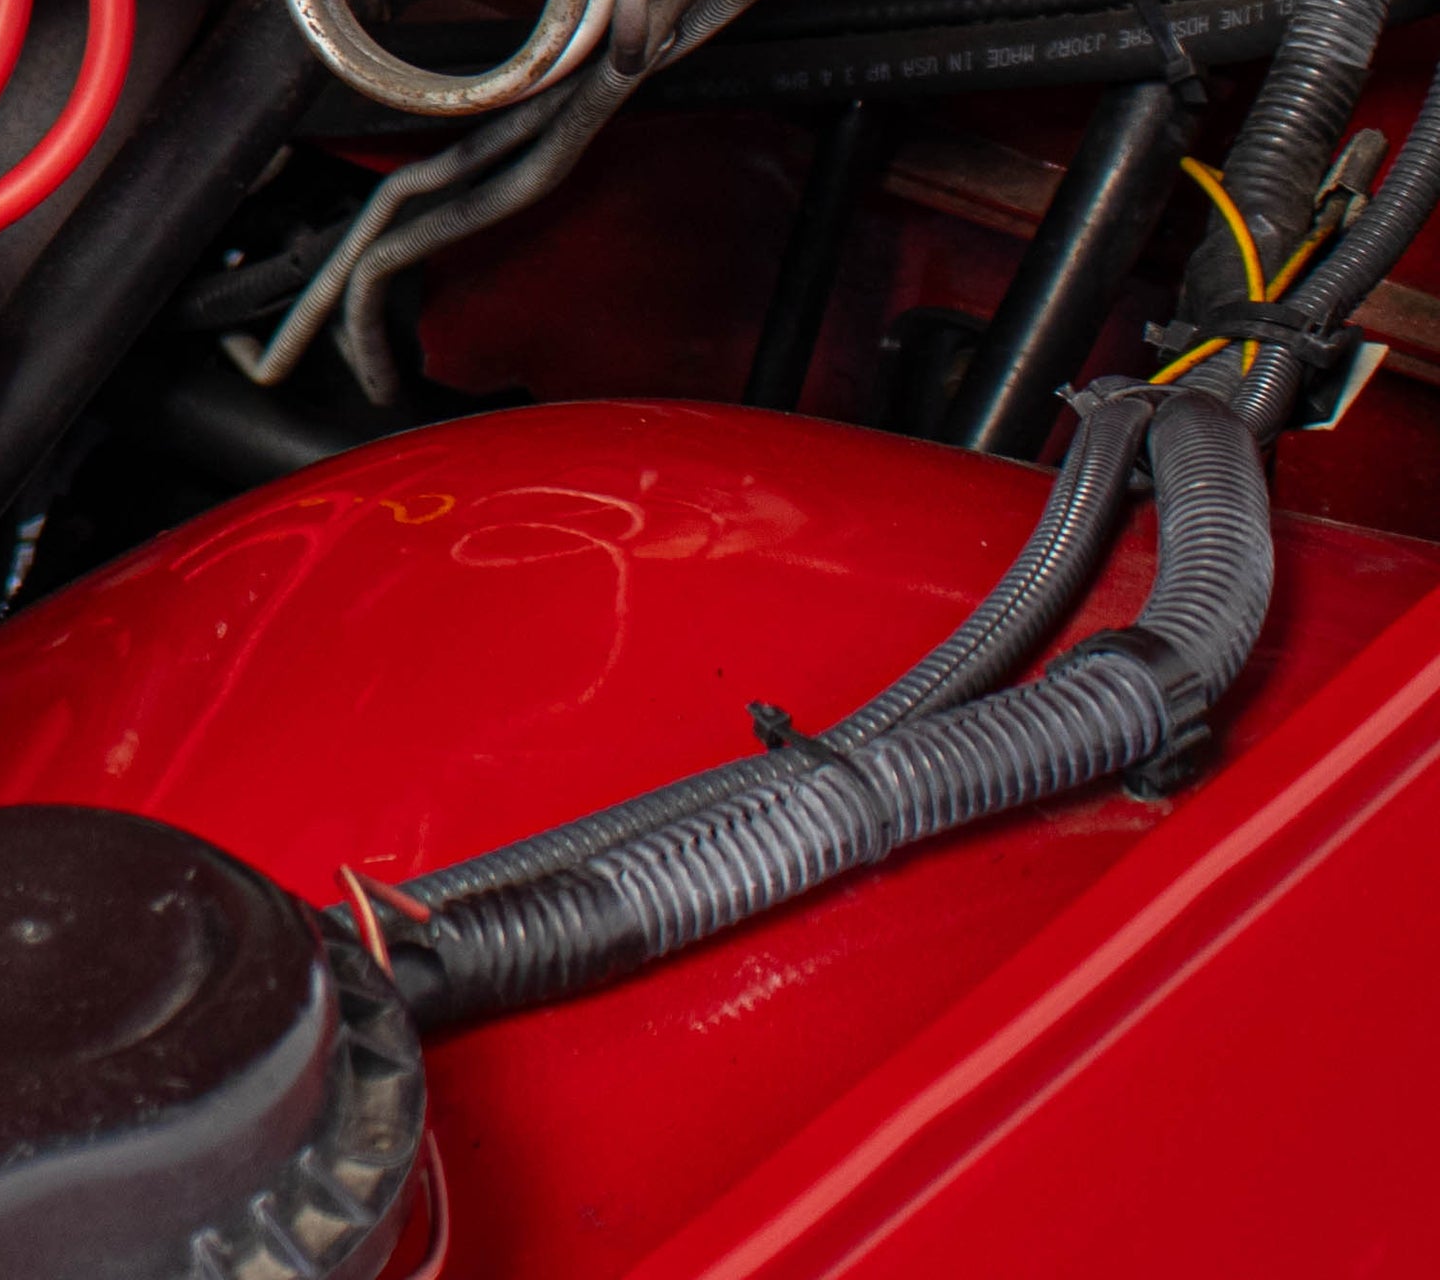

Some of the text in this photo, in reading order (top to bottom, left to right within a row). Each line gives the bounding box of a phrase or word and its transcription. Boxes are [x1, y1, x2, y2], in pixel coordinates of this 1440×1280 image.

[1219, 2, 1265, 31] LINE
[902, 55, 938, 79] USA
[949, 52, 973, 73] IN
[985, 44, 1036, 70] MADE
